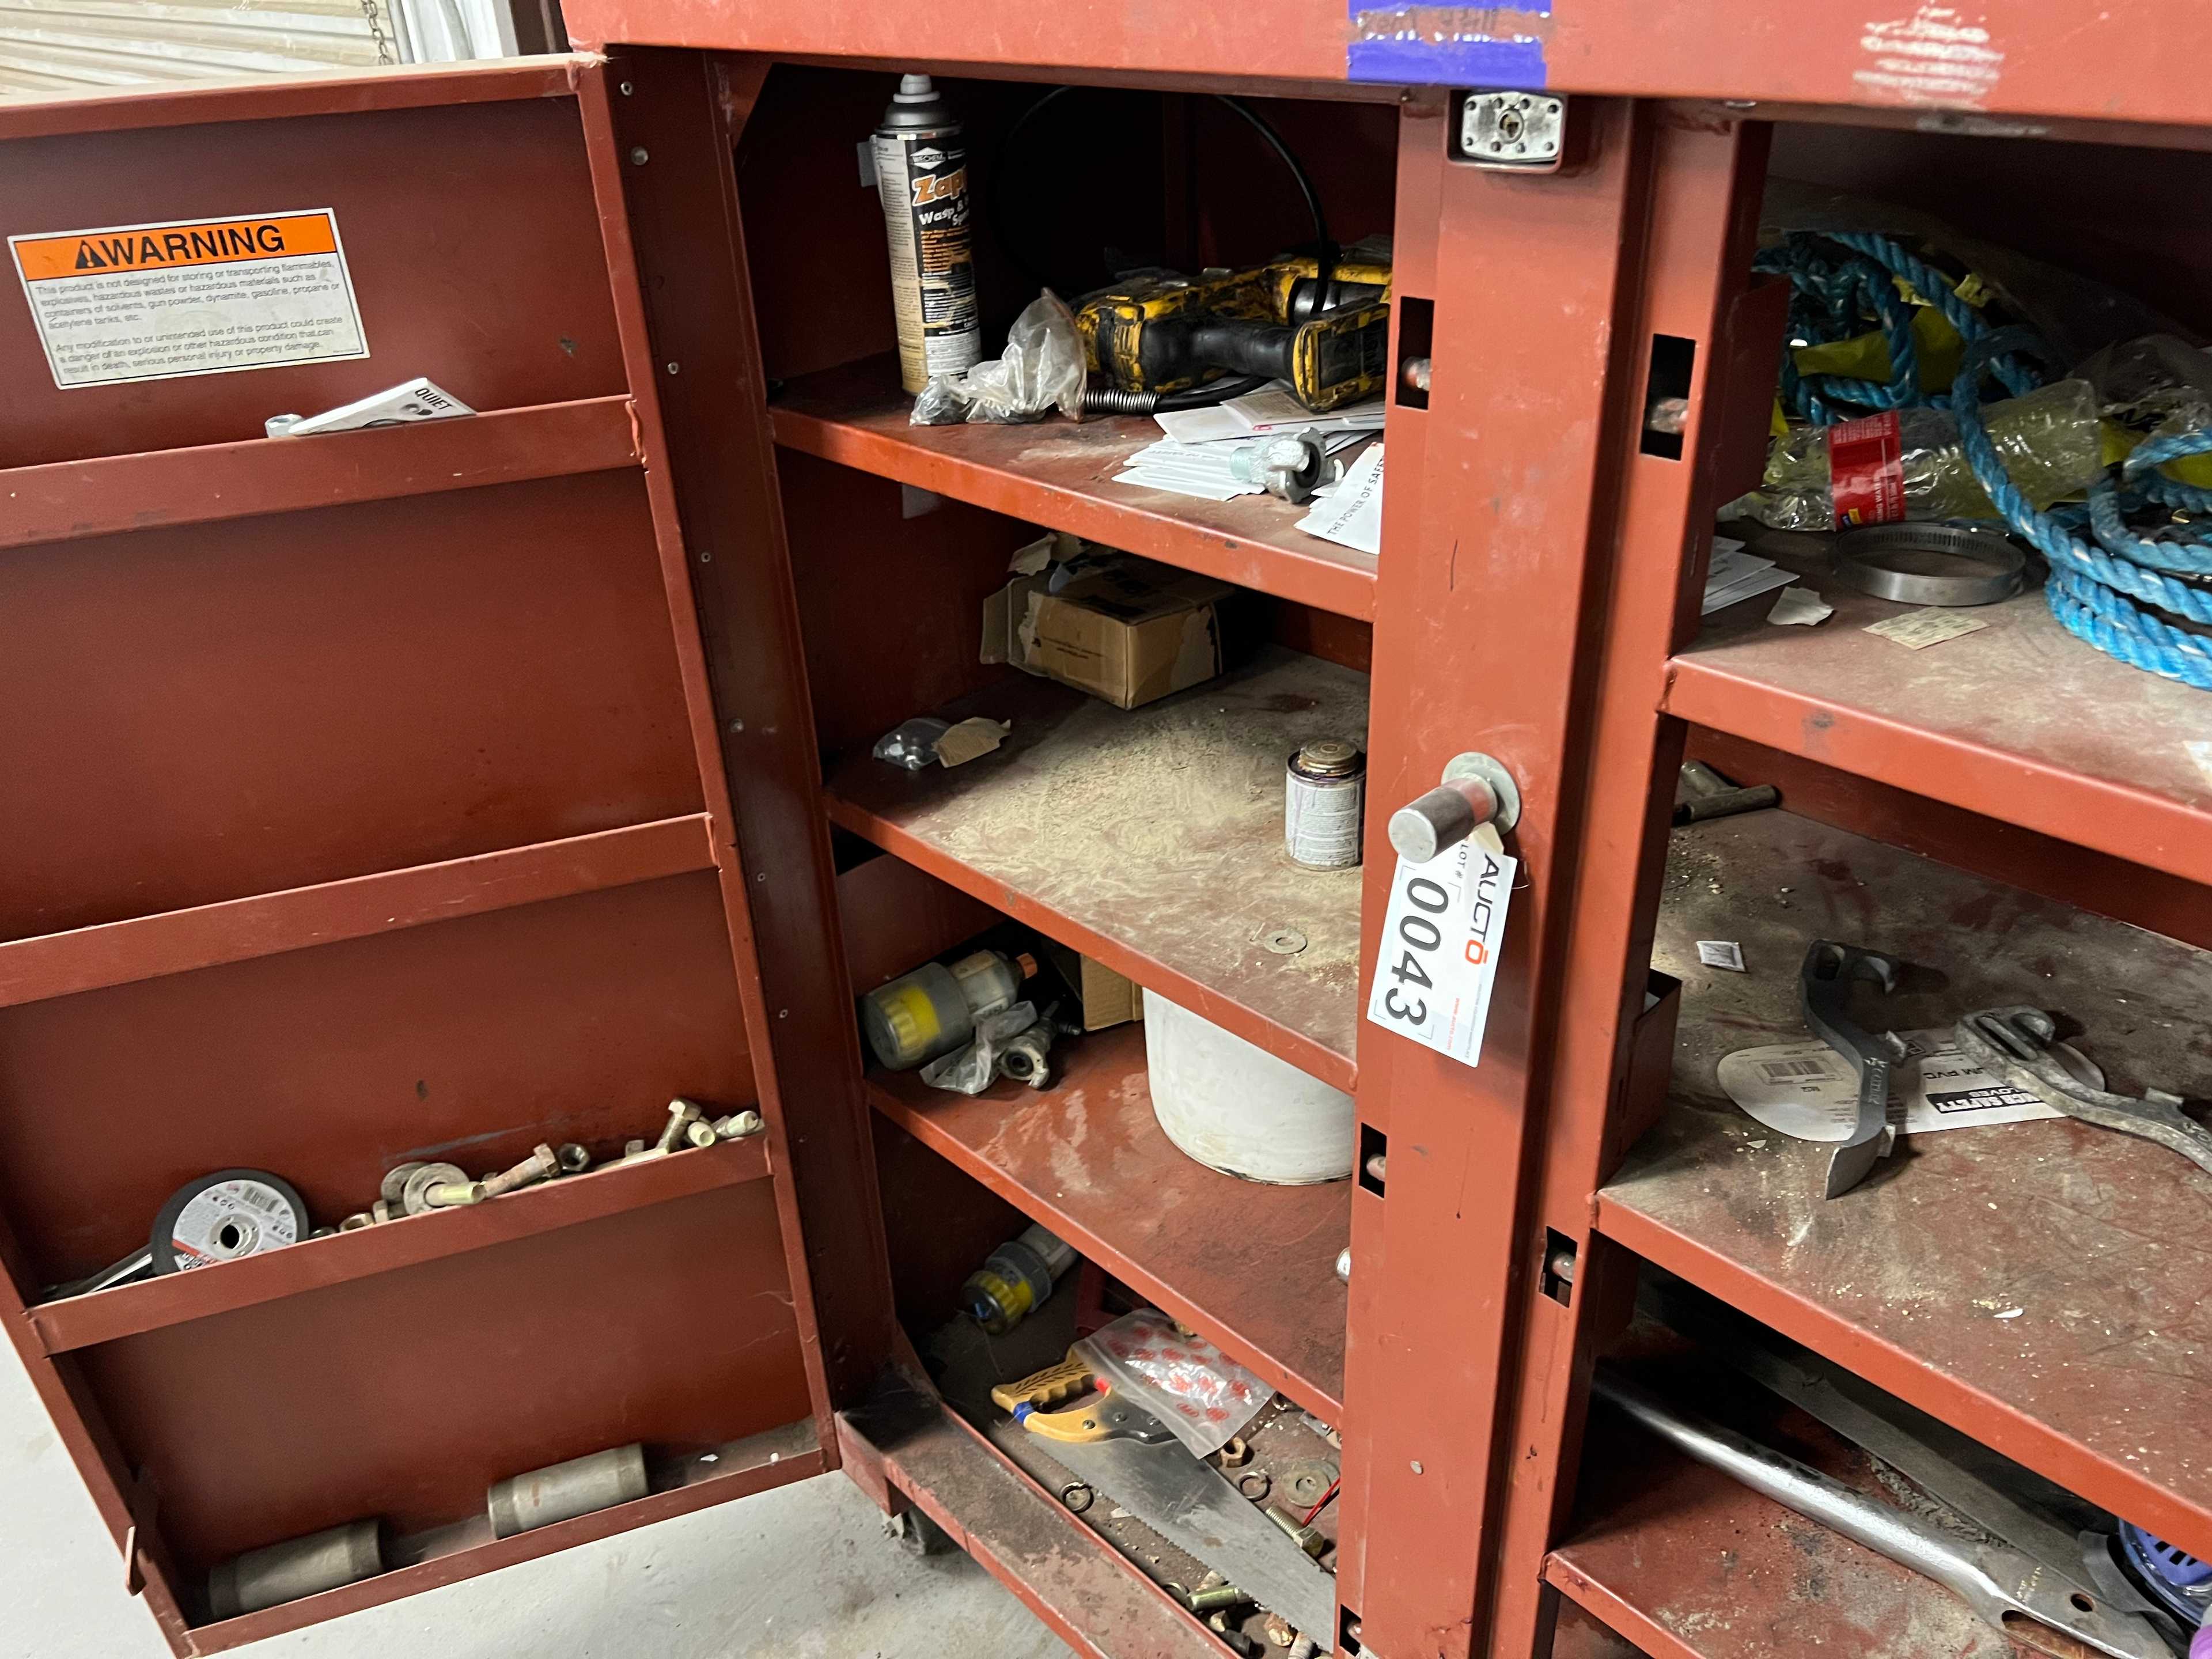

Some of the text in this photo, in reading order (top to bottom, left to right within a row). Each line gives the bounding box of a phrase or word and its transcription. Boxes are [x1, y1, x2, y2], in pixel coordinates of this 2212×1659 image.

[919, 208, 955, 225] Wasp
[99, 225, 285, 266] WARNING
[58, 283, 93, 294] product
[123, 276, 165, 287] designed
[182, 271, 213, 282] storing
[226, 265, 280, 278] transporting
[94, 291, 141, 300] hazardous
[190, 282, 236, 291] hazardous
[240, 278, 279, 286] materials
[44, 307, 92, 317] containers
[294, 285, 328, 294] propane
[56, 344, 74, 353] Any
[76, 338, 130, 349] modification
[156, 331, 205, 340] unintended
[256, 323, 289, 332] product
[67, 353, 100, 363] danger
[128, 346, 171, 357] explosion
[209, 337, 255, 346] hazardous
[258, 333, 297, 342] condition
[167, 353, 206, 364] personal
[207, 350, 232, 360] injury
[247, 345, 283, 356] property
[415, 388, 453, 410] QUIET
[1327, 521, 1345, 535] THE
[1339, 500, 1366, 521] POWER
[1361, 486, 1372, 498] OF
[1457, 844, 1467, 869] LOT
[1385, 877, 1449, 1025] 0043
[1923, 1070, 1960, 1079] PVC
[1936, 1097, 2003, 1112] SAFETY
[1968, 1088, 2020, 1097] LOVES
